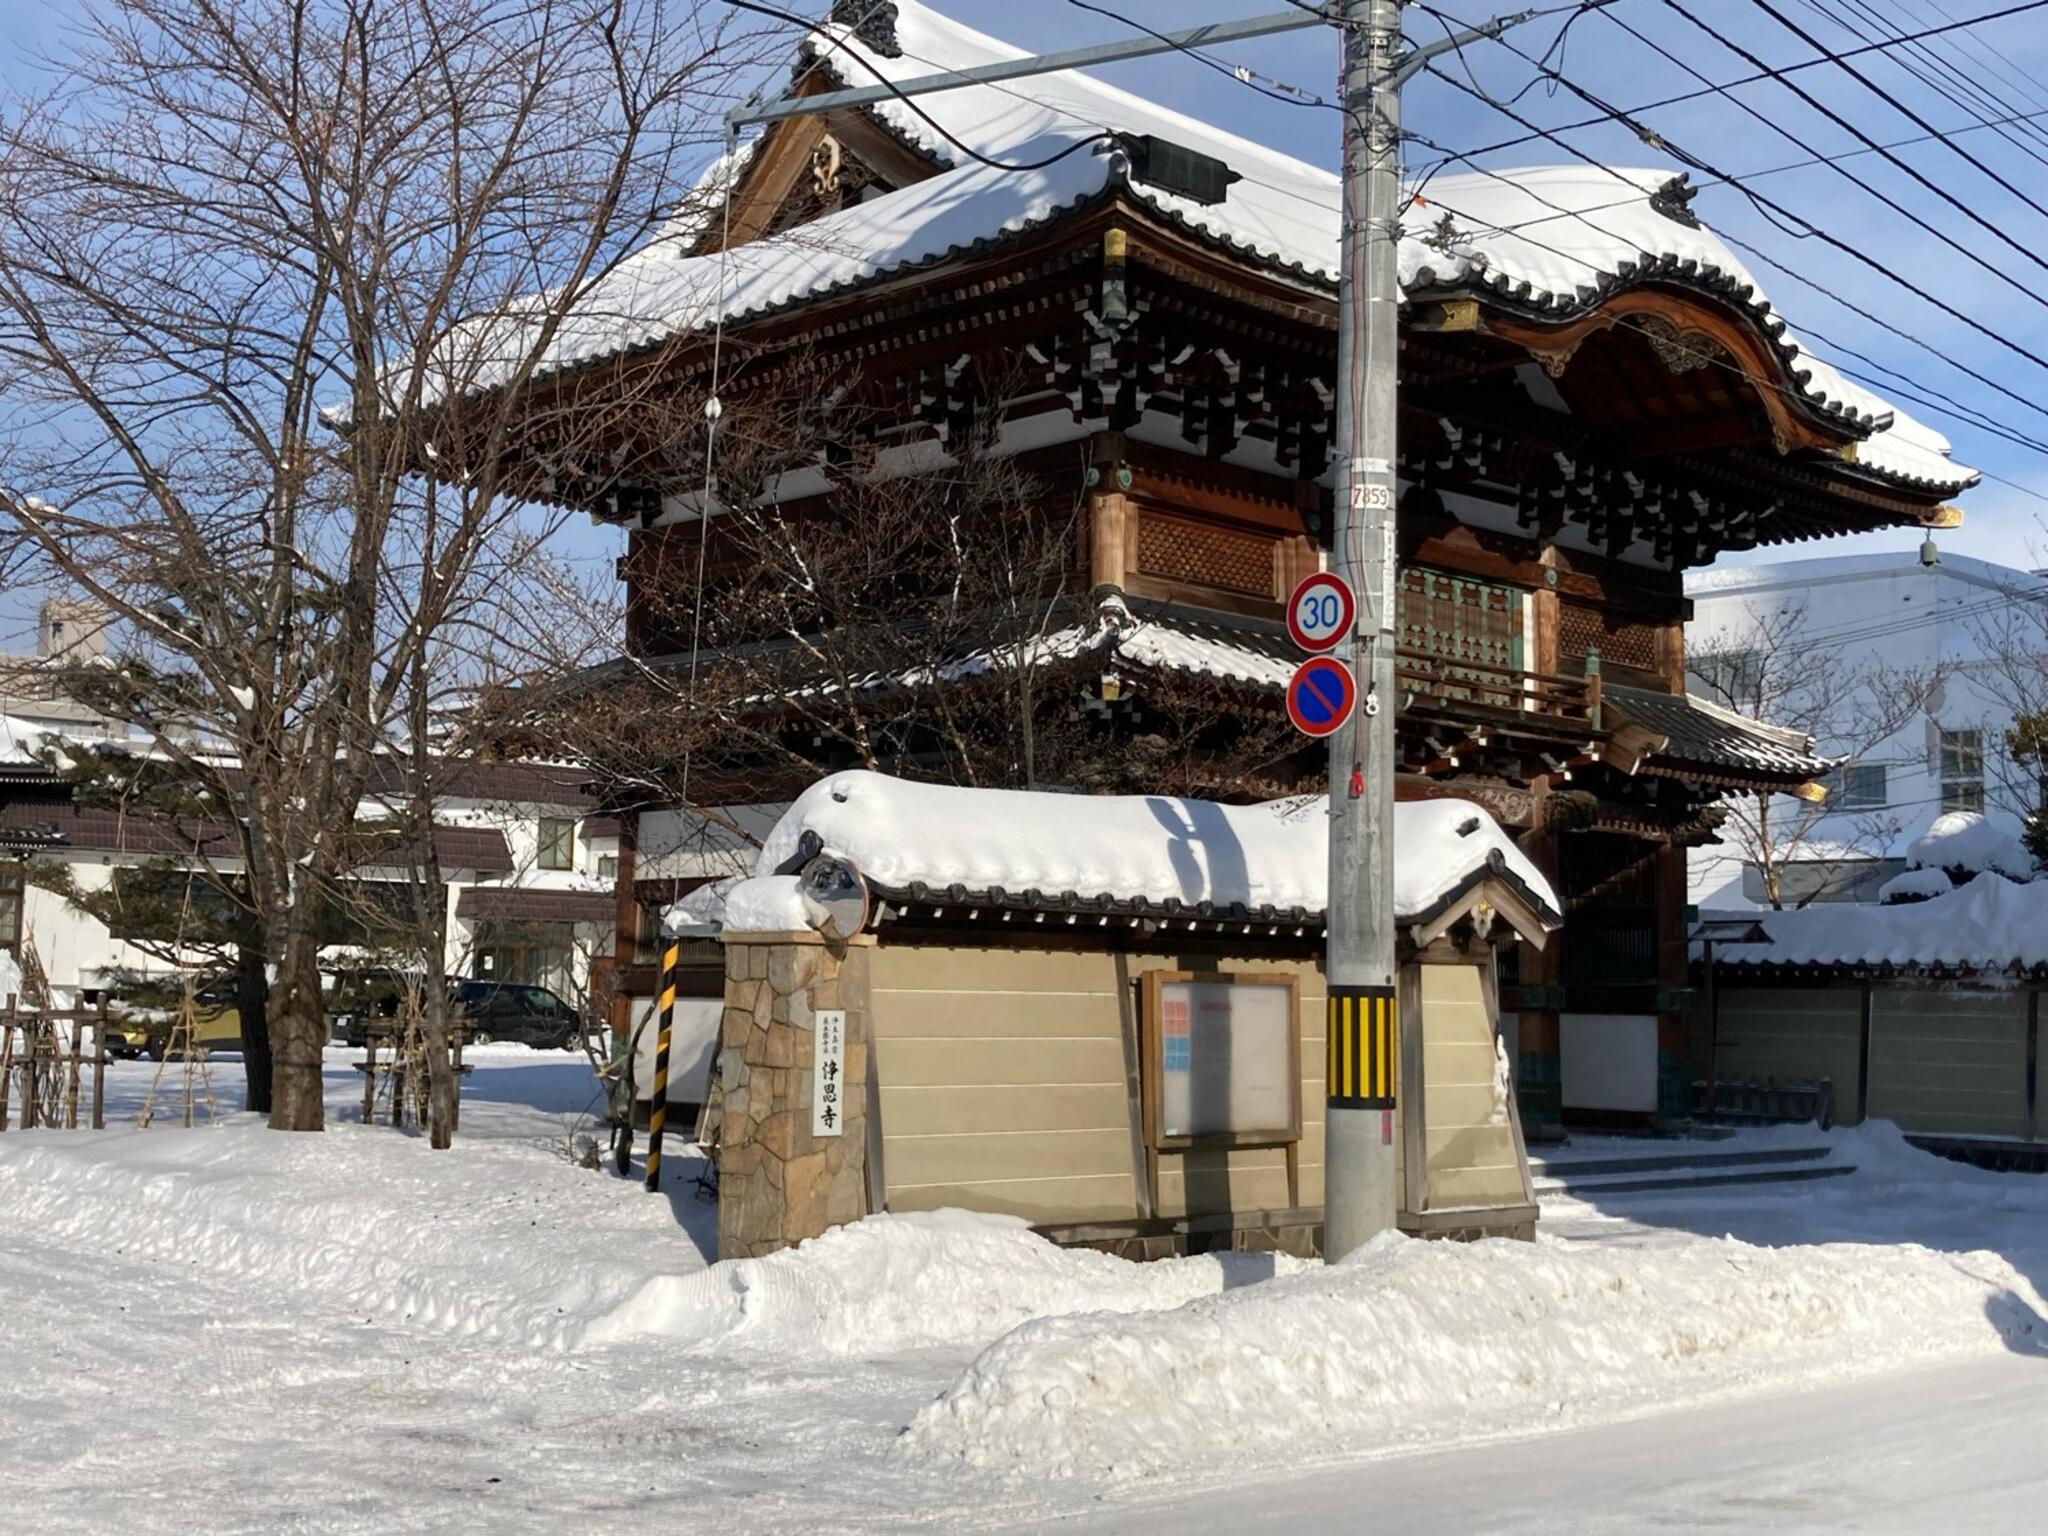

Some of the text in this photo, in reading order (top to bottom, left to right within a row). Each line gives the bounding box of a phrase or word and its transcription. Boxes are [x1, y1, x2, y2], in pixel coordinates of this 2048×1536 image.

[1354, 487, 1388, 506] 7859
[1303, 594, 1338, 630] 30
[821, 1059, 839, 1129] 浄恩寺
